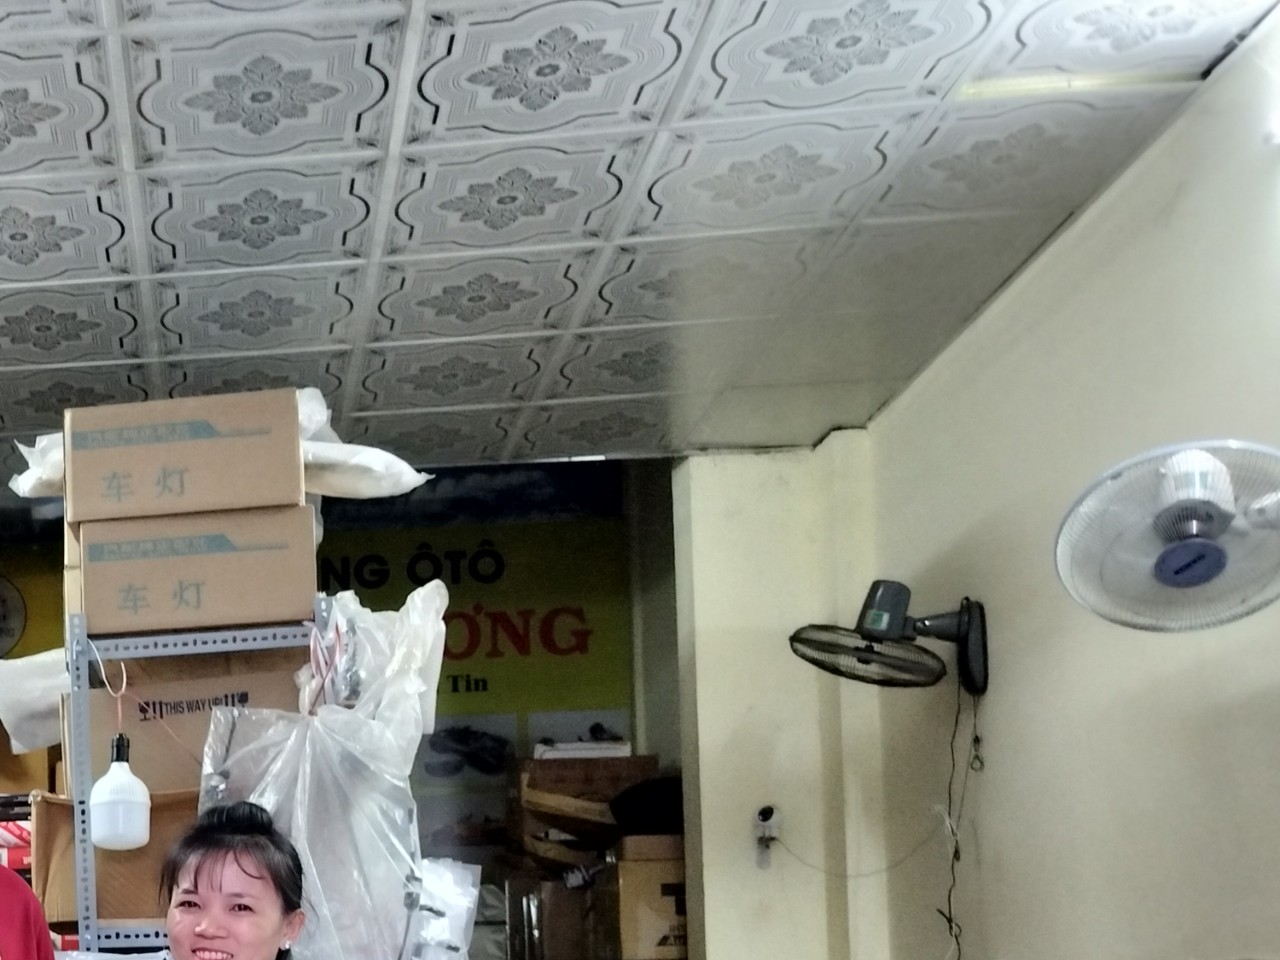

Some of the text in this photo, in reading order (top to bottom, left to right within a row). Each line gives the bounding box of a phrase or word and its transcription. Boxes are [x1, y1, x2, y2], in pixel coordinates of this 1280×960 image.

[406, 539, 505, 586] ÔTÔ
[447, 674, 488, 693] Tin
[164, 702, 184, 716] THIS
[186, 699, 207, 713] WAY
